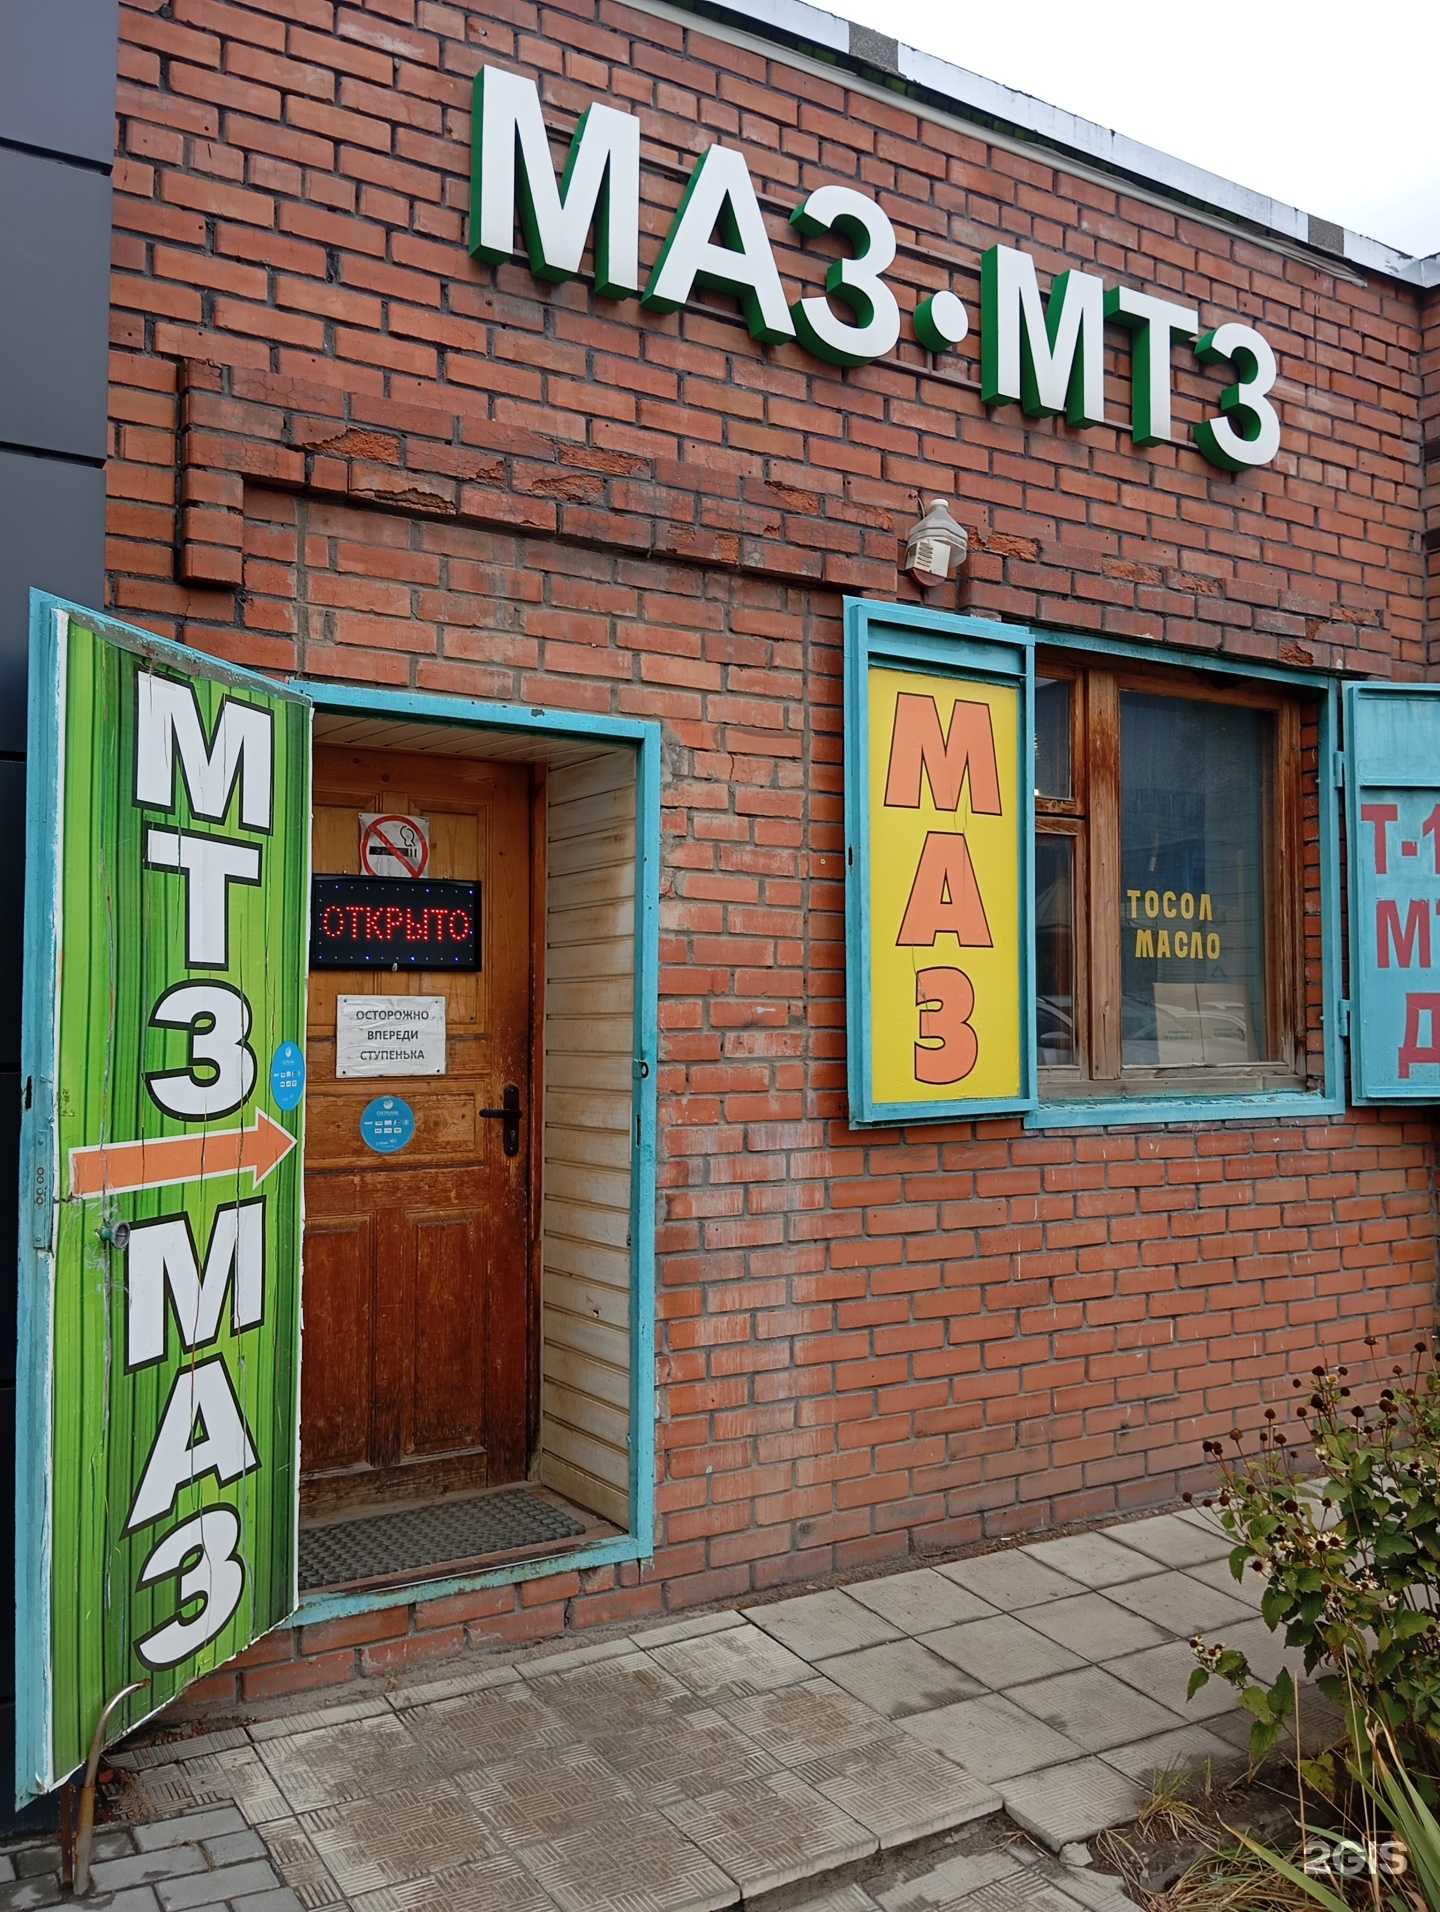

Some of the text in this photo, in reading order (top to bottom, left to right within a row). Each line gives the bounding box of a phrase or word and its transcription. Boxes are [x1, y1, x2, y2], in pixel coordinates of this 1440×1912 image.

[132, 663, 276, 1122] МТЗ
[884, 691, 1002, 1084] МАЗ
[1127, 889, 1213, 921] ТОСОЛ
[322, 904, 472, 941] ОТКРЫТО
[1375, 898, 1440, 968] М
[1135, 928, 1222, 960] МАСЛО
[355, 1009, 430, 1021] ОСТОРОЖНО
[367, 1029, 419, 1042] ВПЕРЕДИ
[359, 1049, 425, 1061] СТУПЕНЬКА
[121, 1195, 267, 1672] МАЗ
